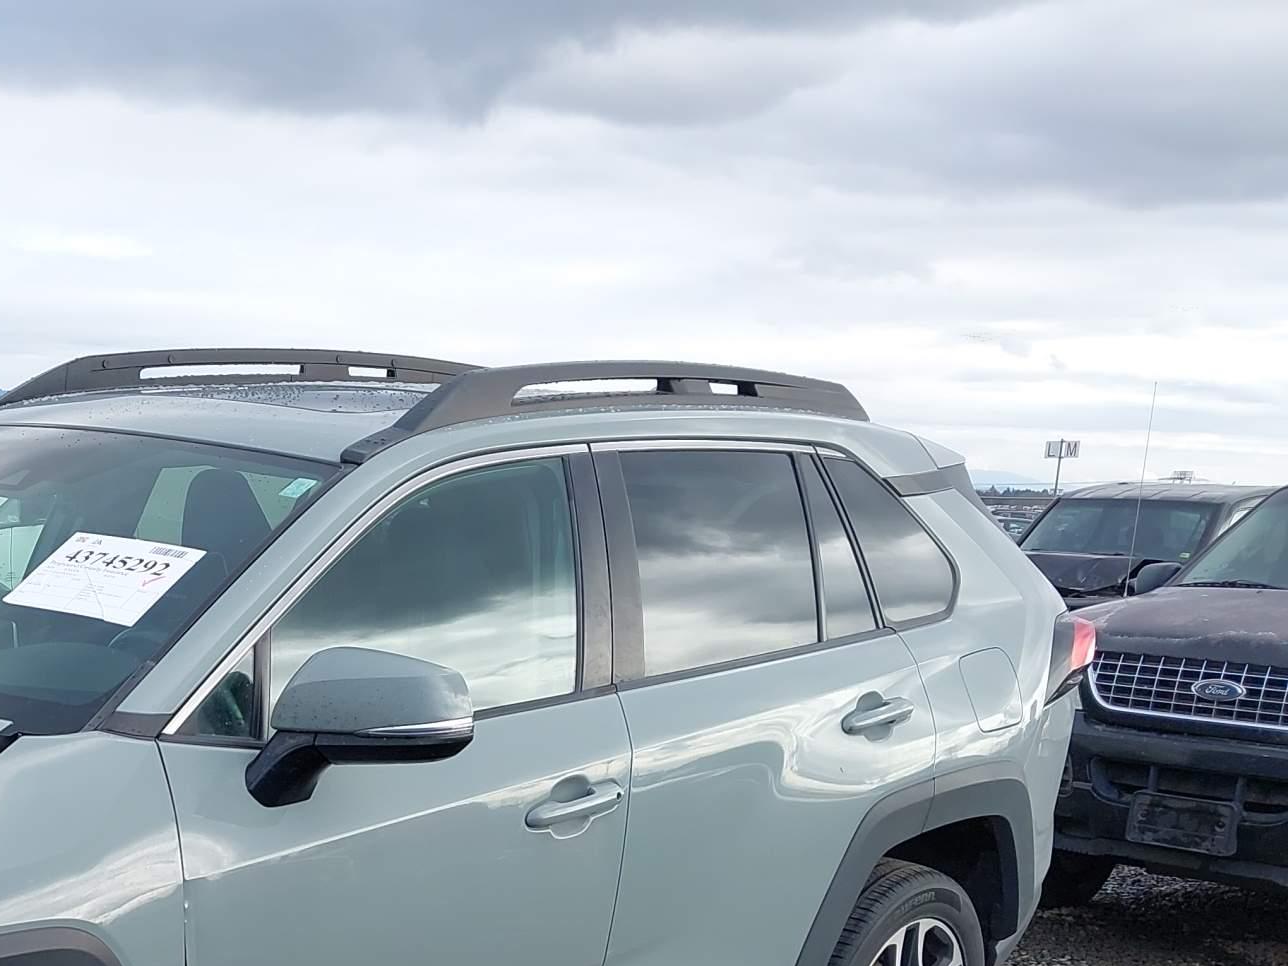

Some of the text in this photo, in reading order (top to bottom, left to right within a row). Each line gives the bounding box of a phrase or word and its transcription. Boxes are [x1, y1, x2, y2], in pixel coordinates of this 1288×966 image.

[1066, 442, 1078, 457] M
[65, 549, 171, 576] 43745292
[1205, 684, 1231, 696] Ford
